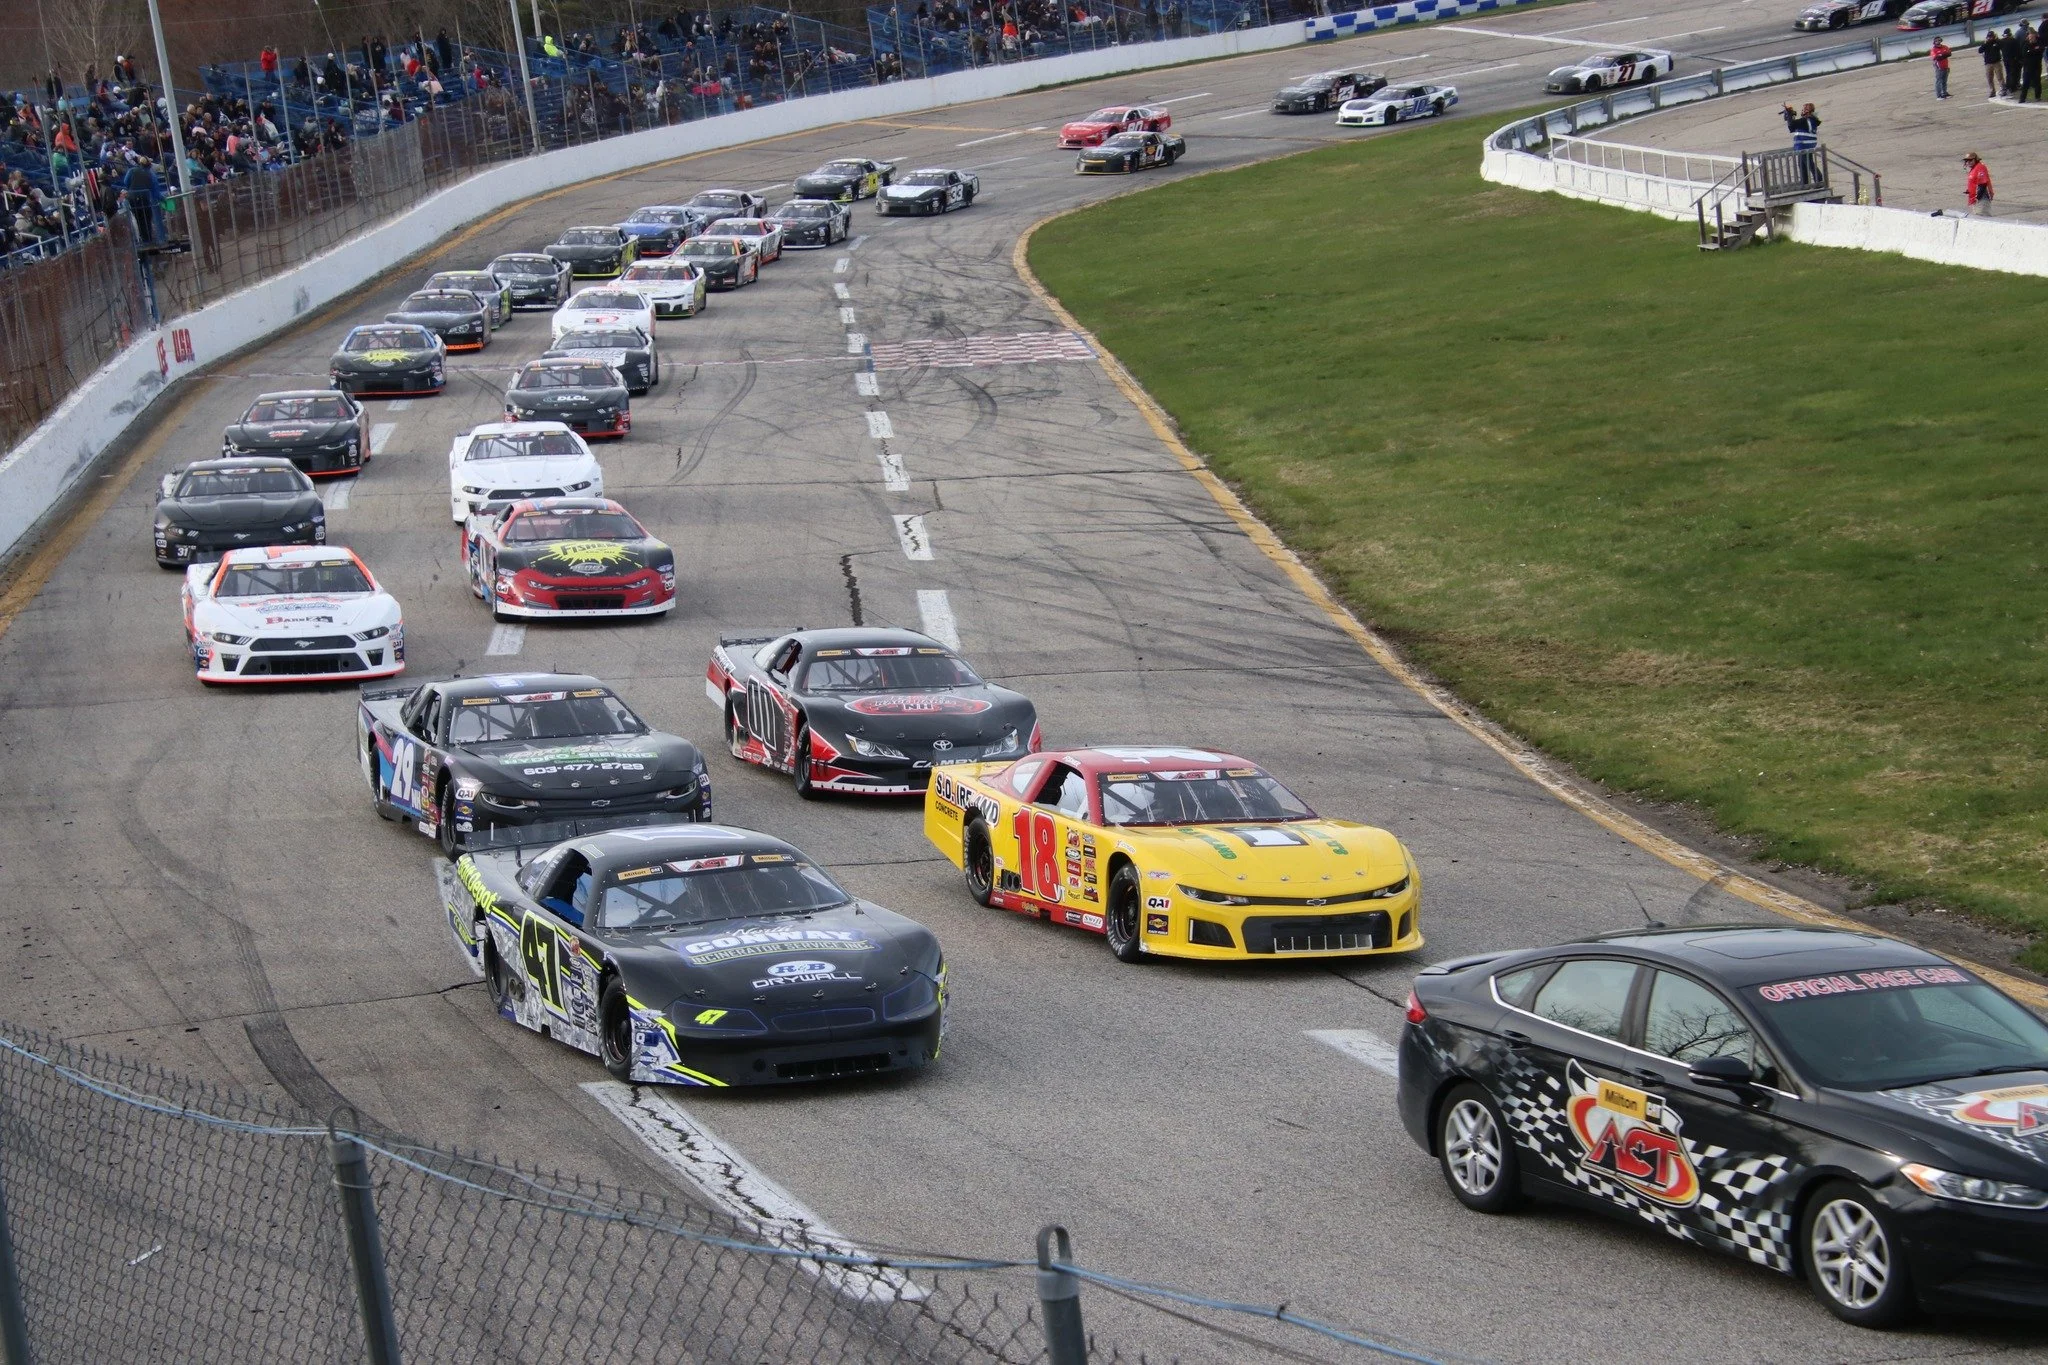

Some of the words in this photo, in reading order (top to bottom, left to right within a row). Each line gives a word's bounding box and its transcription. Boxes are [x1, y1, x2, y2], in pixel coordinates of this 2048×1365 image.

[1861, 0, 1884, 18] 19
[1972, 0, 1993, 14] 21
[1618, 63, 1636, 83] 27
[1338, 86, 1353, 101] 23
[1155, 144, 1164, 161] 0
[950, 184, 964, 203] 33
[177, 548, 188, 557] 31
[747, 675, 777, 750] 00
[391, 737, 415, 801] 29
[936, 773, 954, 802] S.D.
[936, 800, 958, 821] CONCRETE
[688, 857, 728, 870] ACT
[1013, 806, 1061, 902] 18
[624, 869, 646, 877] Milton
[1147, 898, 1170, 908] QA1
[686, 930, 854, 953] CONWAY
[693, 943, 780, 964] INCINERATOR
[785, 940, 839, 950] SERVICE
[520, 909, 567, 1016] 47
[776, 963, 826, 973] R&B
[752, 972, 863, 988] DRYWALL
[1759, 976, 1867, 1002] OFFICIAL
[1857, 969, 1924, 989] PACE
[1917, 968, 1969, 984] CAR
[695, 1009, 728, 1024] 47
[1605, 1089, 1638, 1111] Milton
[1586, 1117, 1682, 1186] ACT
